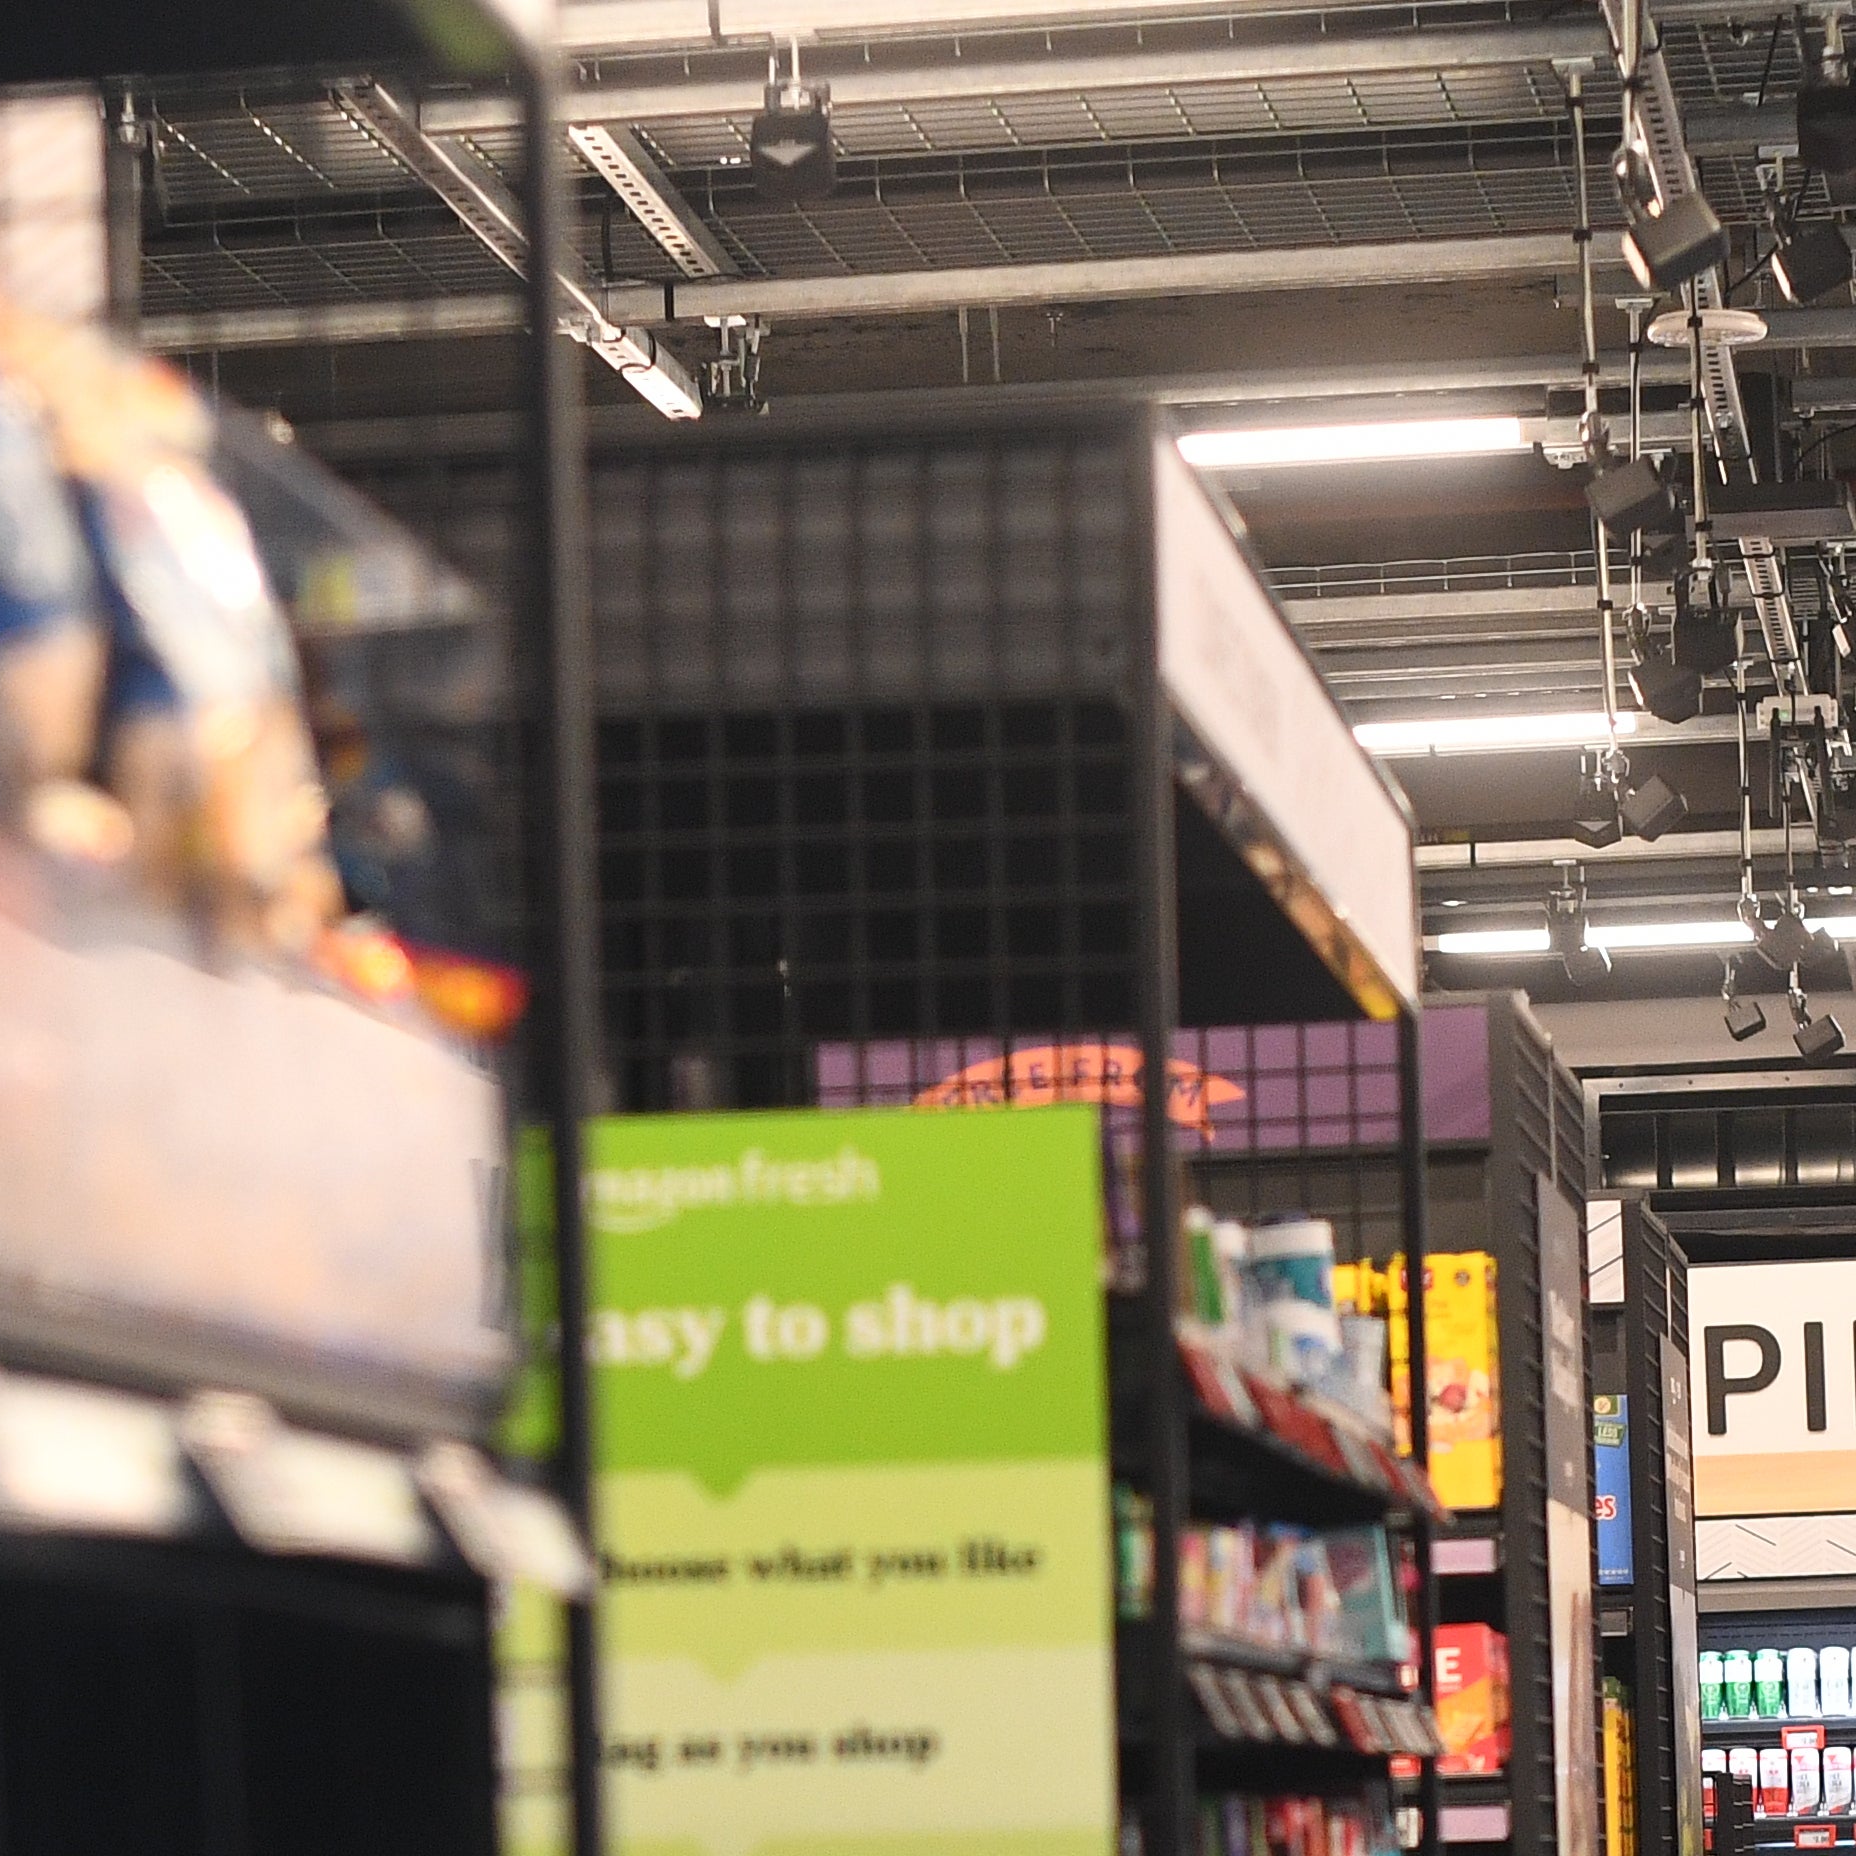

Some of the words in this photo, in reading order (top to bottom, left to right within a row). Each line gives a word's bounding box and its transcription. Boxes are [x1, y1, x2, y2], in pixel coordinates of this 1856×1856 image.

[587, 1304, 724, 1380] asy
[744, 1294, 828, 1362] to
[844, 1284, 1047, 1370] shop
[600, 1544, 729, 1585] hoose
[605, 1732, 658, 1771] ag
